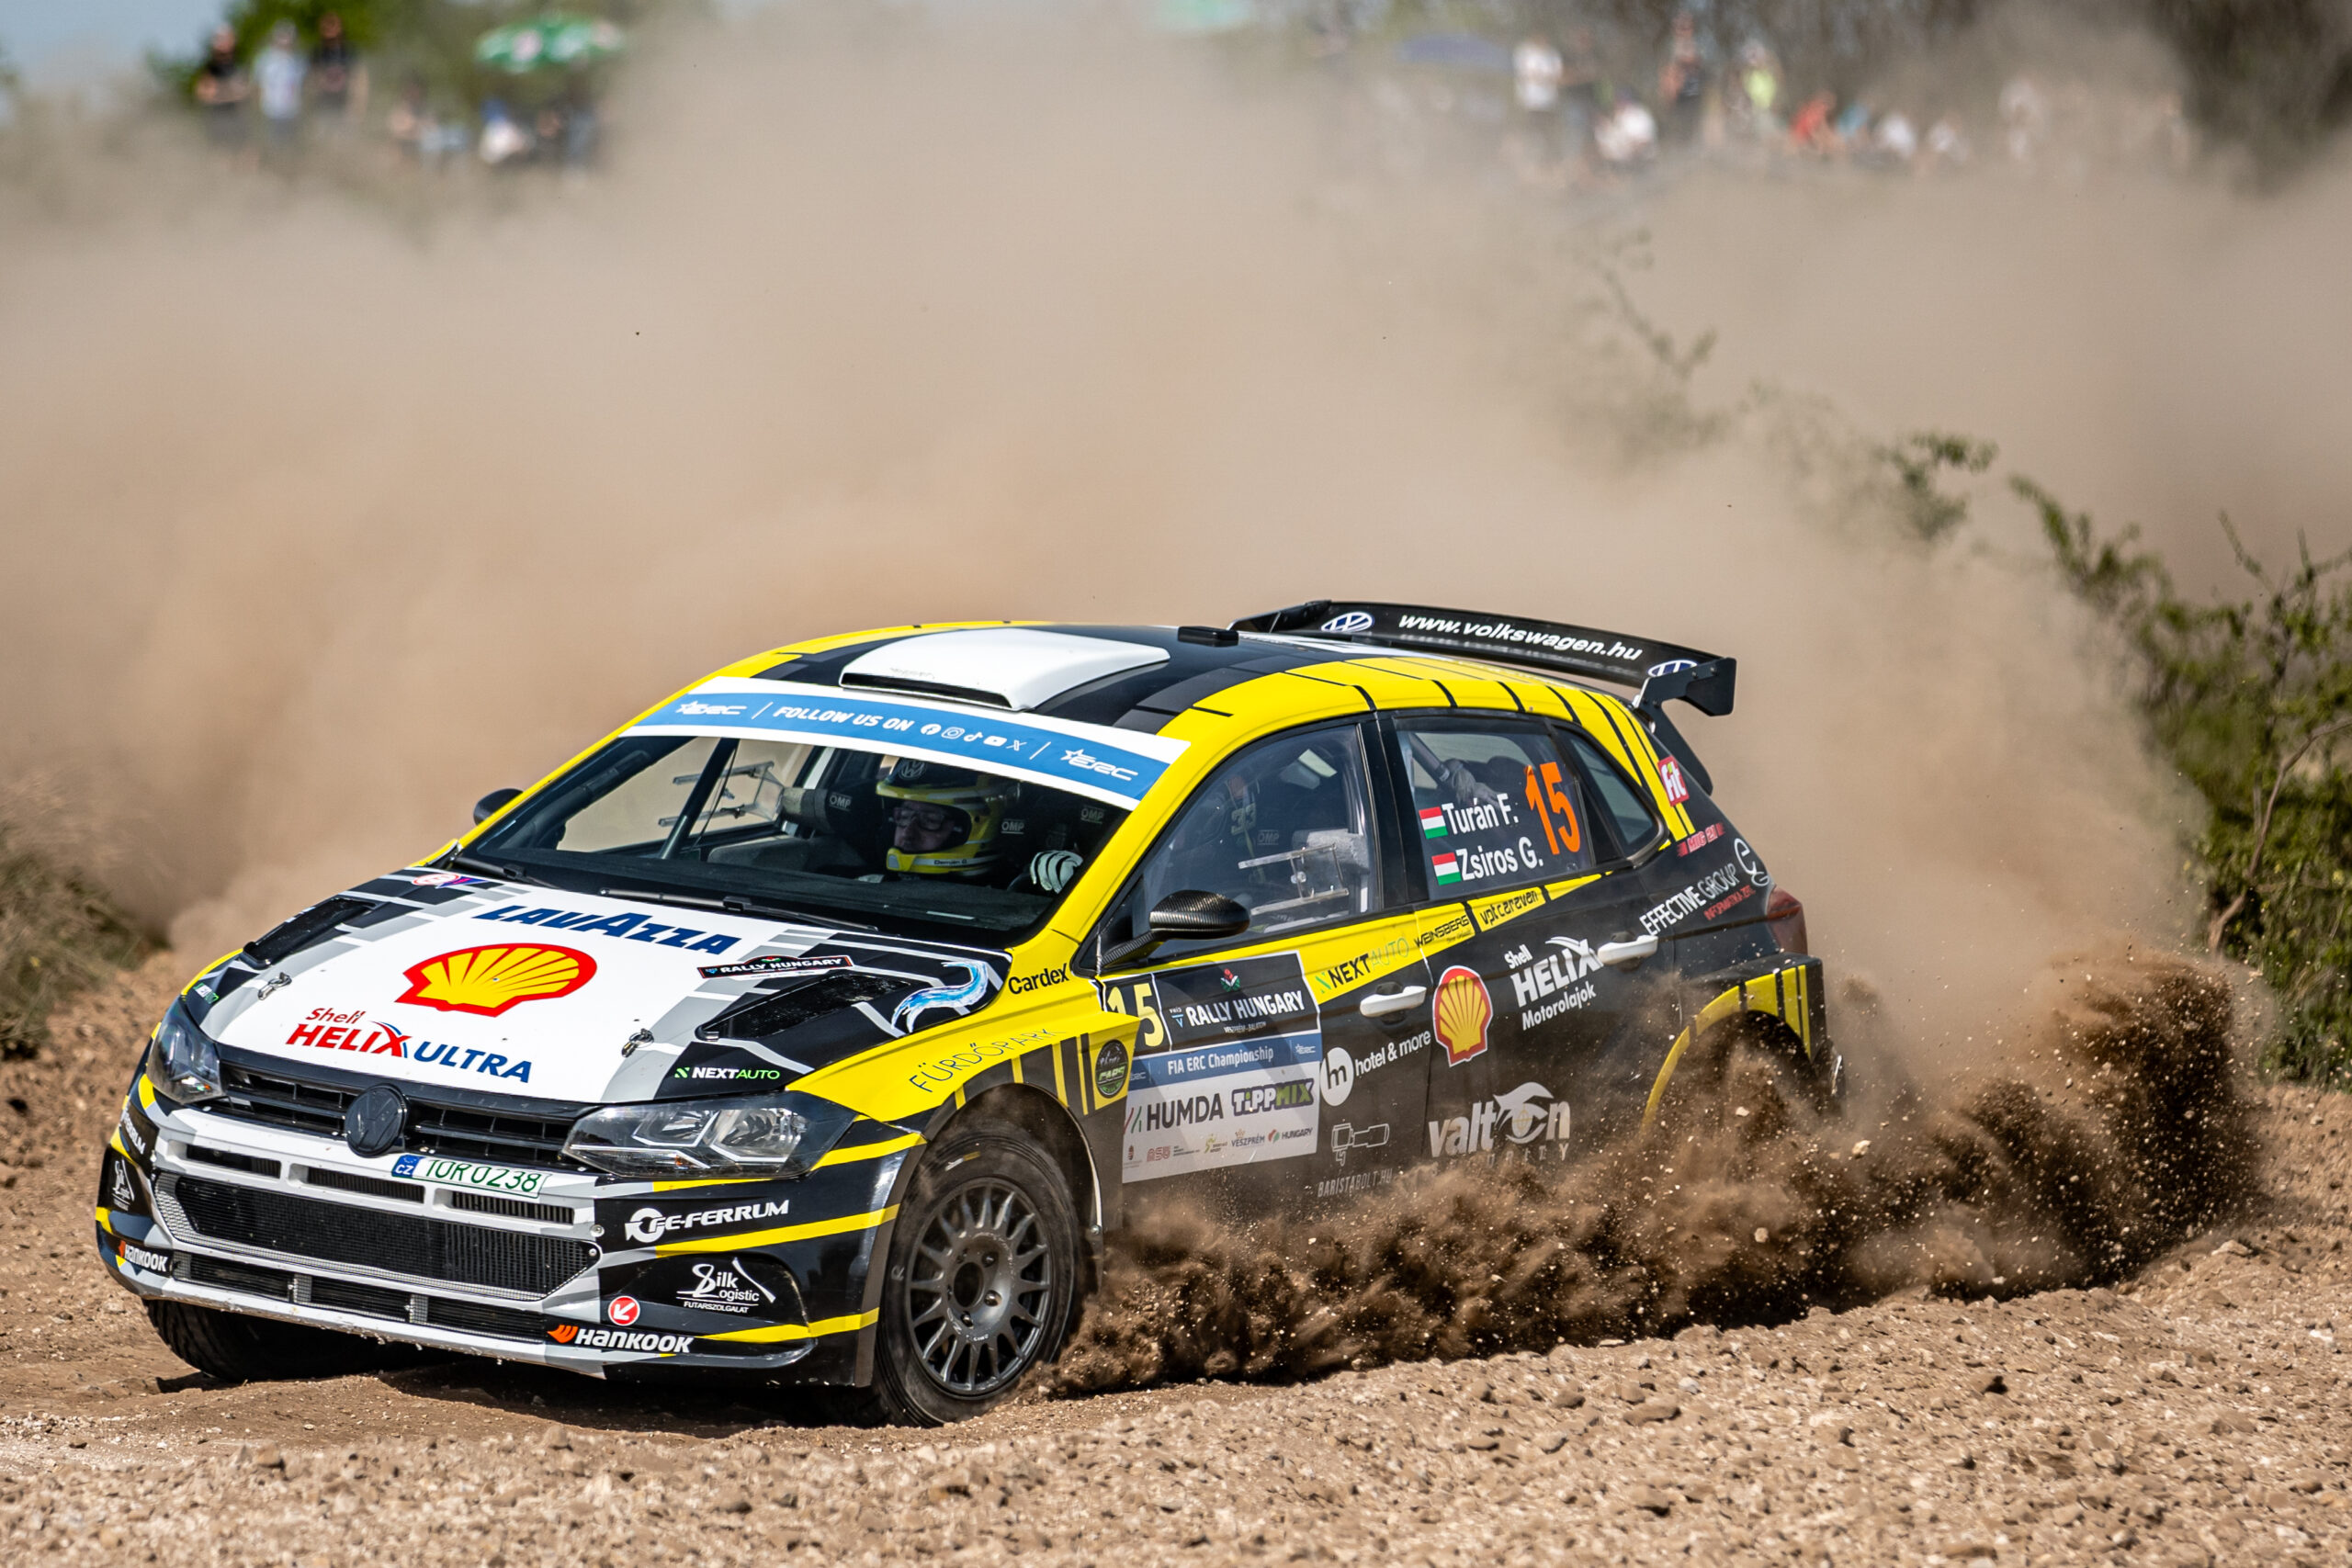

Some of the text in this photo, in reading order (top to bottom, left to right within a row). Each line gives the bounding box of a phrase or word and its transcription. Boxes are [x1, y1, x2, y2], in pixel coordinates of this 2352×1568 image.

[1399, 615, 1643, 660] www.volkswagen.hu
[773, 706, 915, 731] FOLLOW US ON
[830, 795, 852, 808] OMP
[1442, 793, 1519, 835] Turán F.
[1525, 761, 1580, 854] 15
[1001, 821, 1024, 831] OMP
[1455, 837, 1544, 881] Zsiros G.
[1639, 863, 1740, 936] EFFECTIVE GROUP
[470, 905, 742, 955] LAVAZZA
[1414, 914, 1470, 948] WEINSBERG
[720, 964, 766, 974] RALLY
[768, 958, 842, 969] HUNGARY
[1504, 944, 1533, 969] Shell
[1510, 936, 1604, 1008] HELIX
[1009, 964, 1069, 995] Cardex
[306, 1008, 366, 1024] Shell
[1107, 983, 1165, 1047] 15
[1186, 990, 1306, 1026] RALLY HUNGARY
[1522, 980, 1597, 1031] Motorolajok
[286, 1021, 532, 1083] HELIX ULTRA
[1168, 1046, 1274, 1076] FIA ERC Championship
[1354, 1031, 1431, 1078] hotel & more
[1147, 1093, 1224, 1131] HUMDA
[1282, 1127, 1313, 1140] HUNGARY
[395, 1164, 413, 1176] CZ
[470, 1166, 541, 1192] 0238
[649, 1200, 789, 1233] FE-FERRUM
